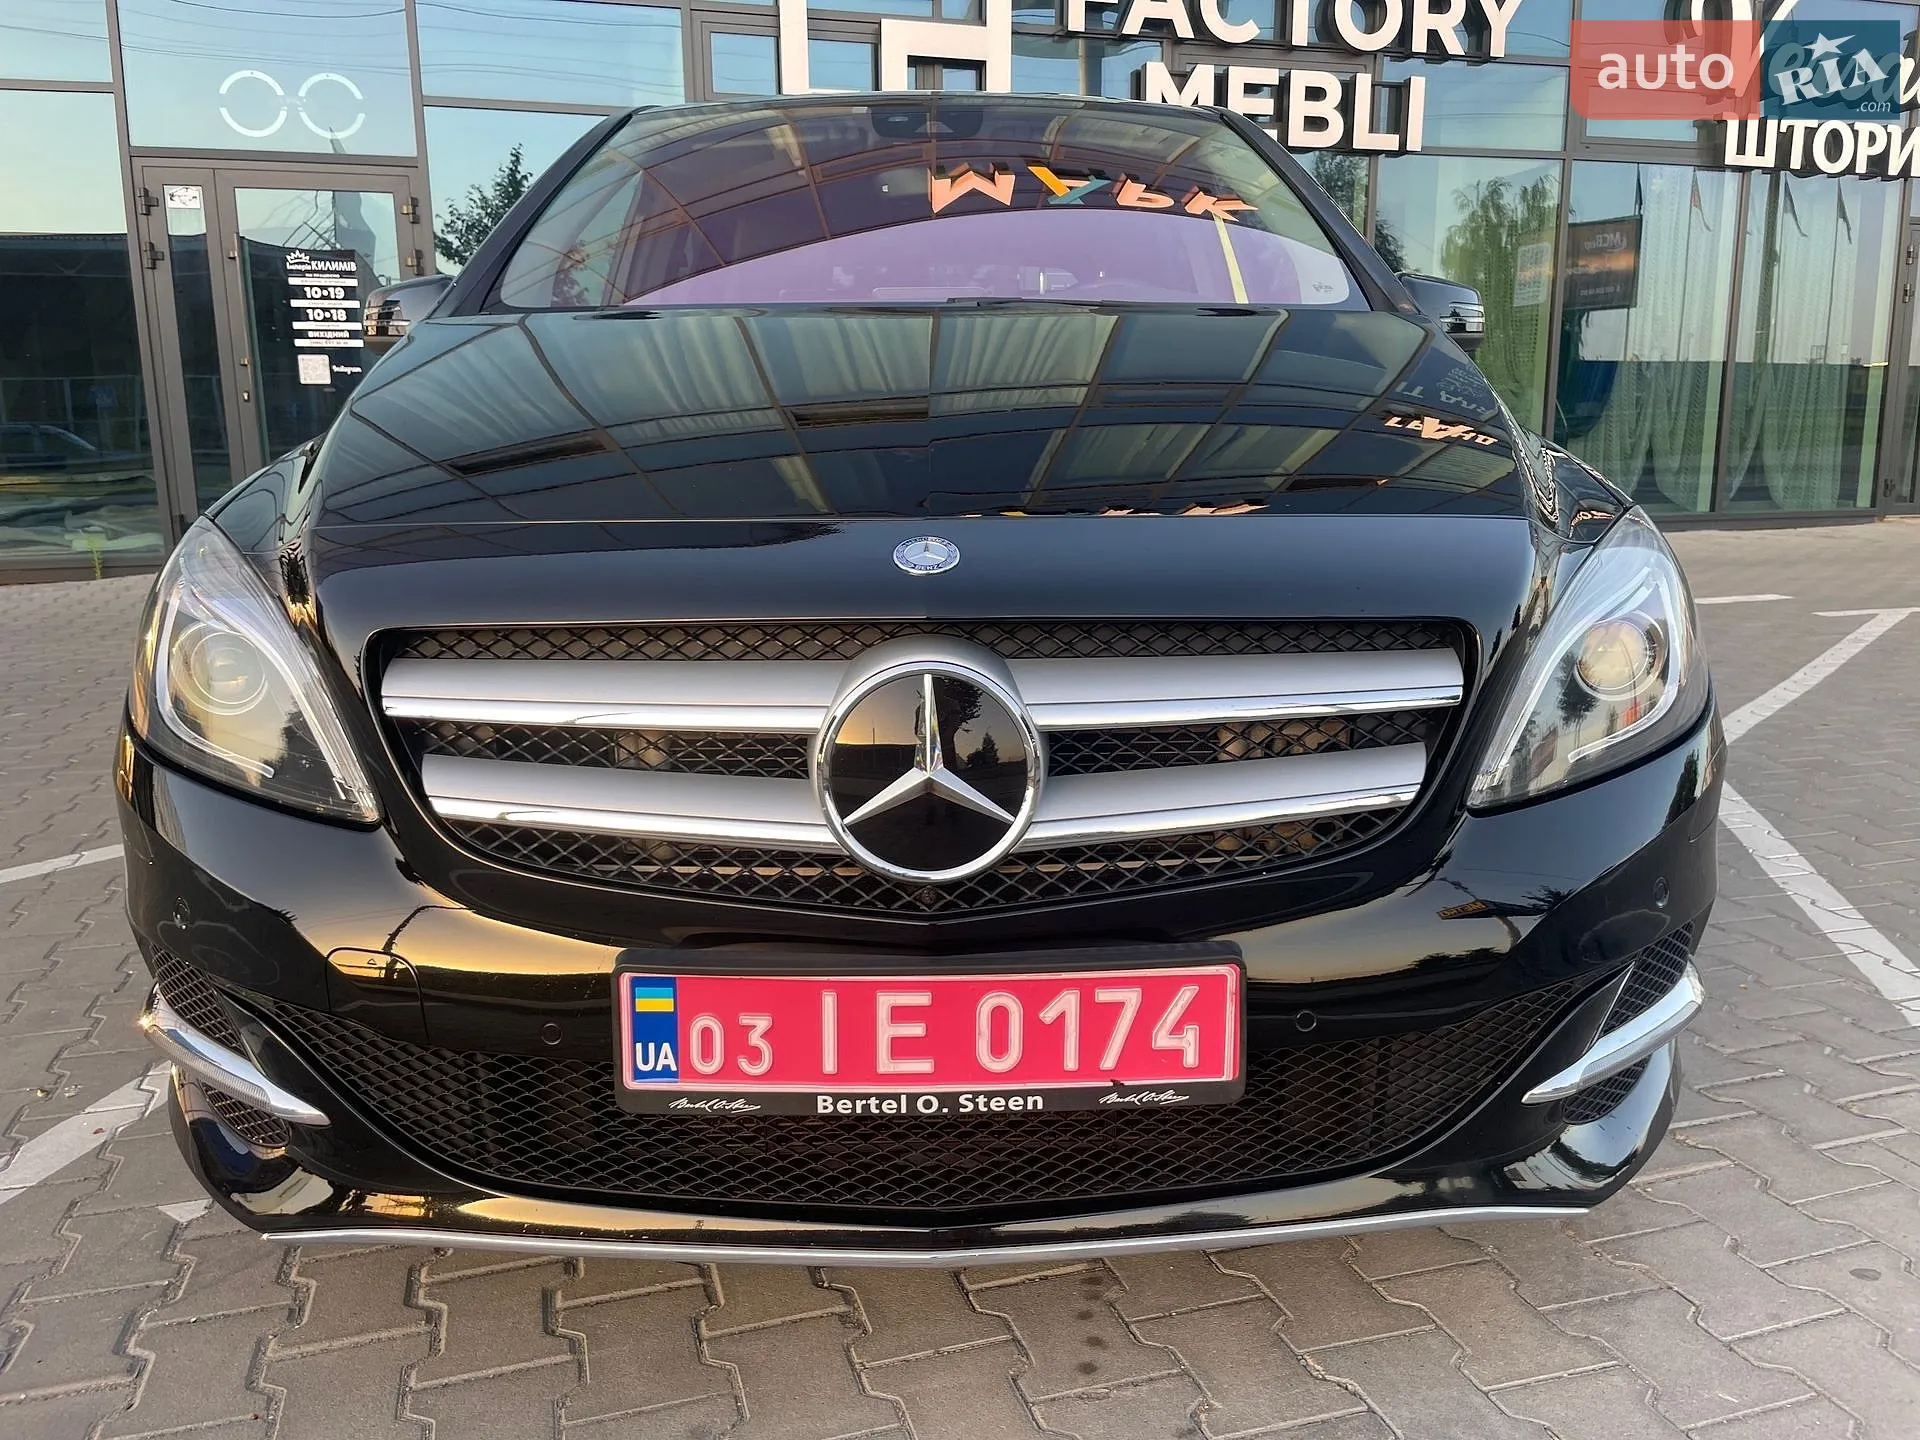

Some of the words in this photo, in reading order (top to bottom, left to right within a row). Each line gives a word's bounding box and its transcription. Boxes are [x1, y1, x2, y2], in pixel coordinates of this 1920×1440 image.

[1145, 62, 1426, 152] MEBLI
[311, 260, 357, 271] КИЛИМІВ
[689, 1012, 774, 1076] 03
[821, 989, 935, 1075] IE
[975, 985, 1200, 1074] 0174
[635, 1042, 678, 1072] UA
[816, 1094, 907, 1114] Bertel
[916, 1095, 949, 1114] O.
[958, 1093, 1044, 1113] Steen
